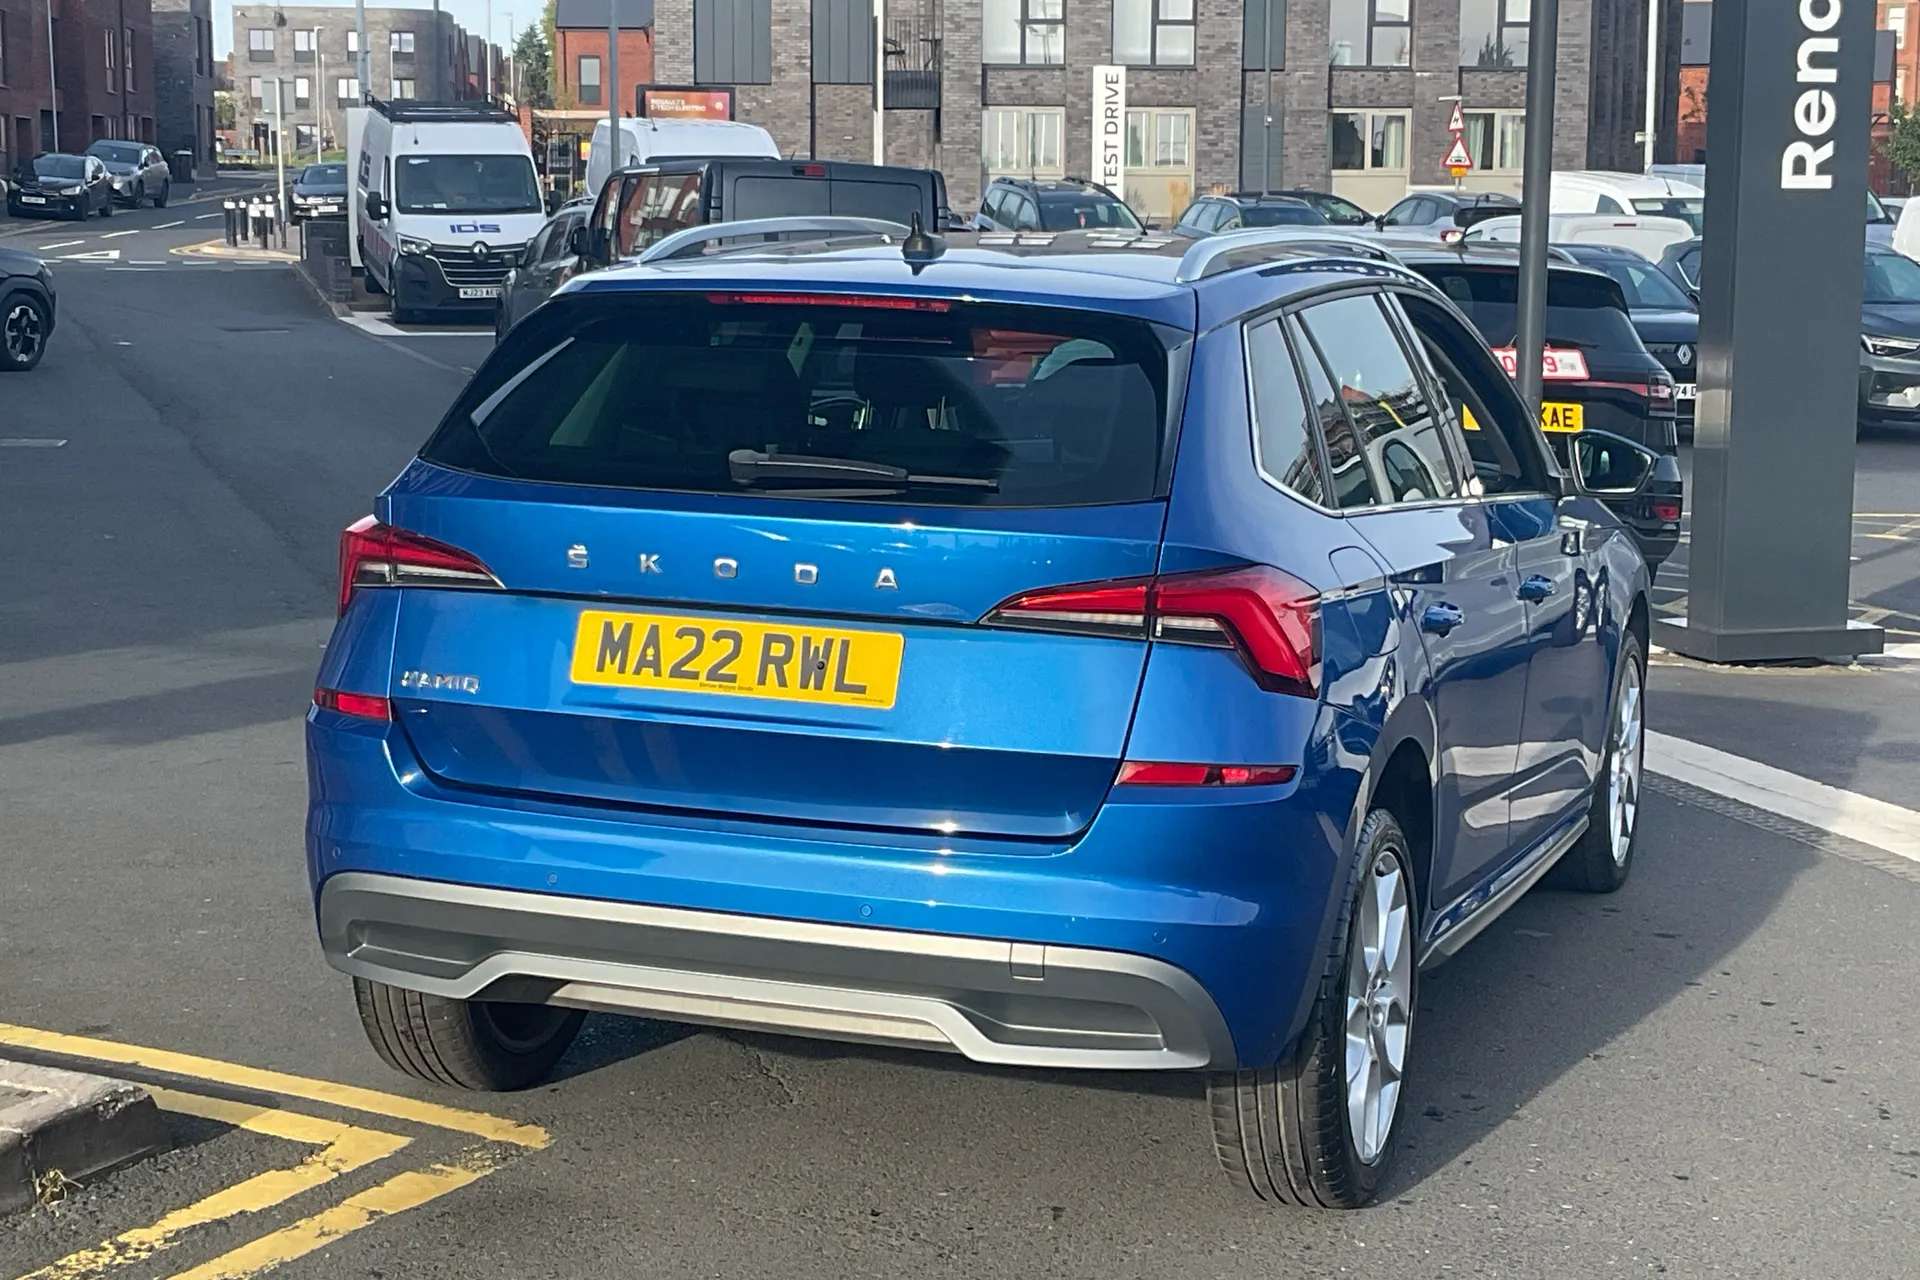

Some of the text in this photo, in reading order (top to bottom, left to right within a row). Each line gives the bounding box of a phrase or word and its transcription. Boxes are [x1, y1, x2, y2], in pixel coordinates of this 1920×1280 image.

[1104, 73, 1119, 187] TEST DRIVE
[450, 224, 501, 233] IDS
[567, 545, 898, 590] ŠKODA
[596, 620, 867, 695] MA22 RWL
